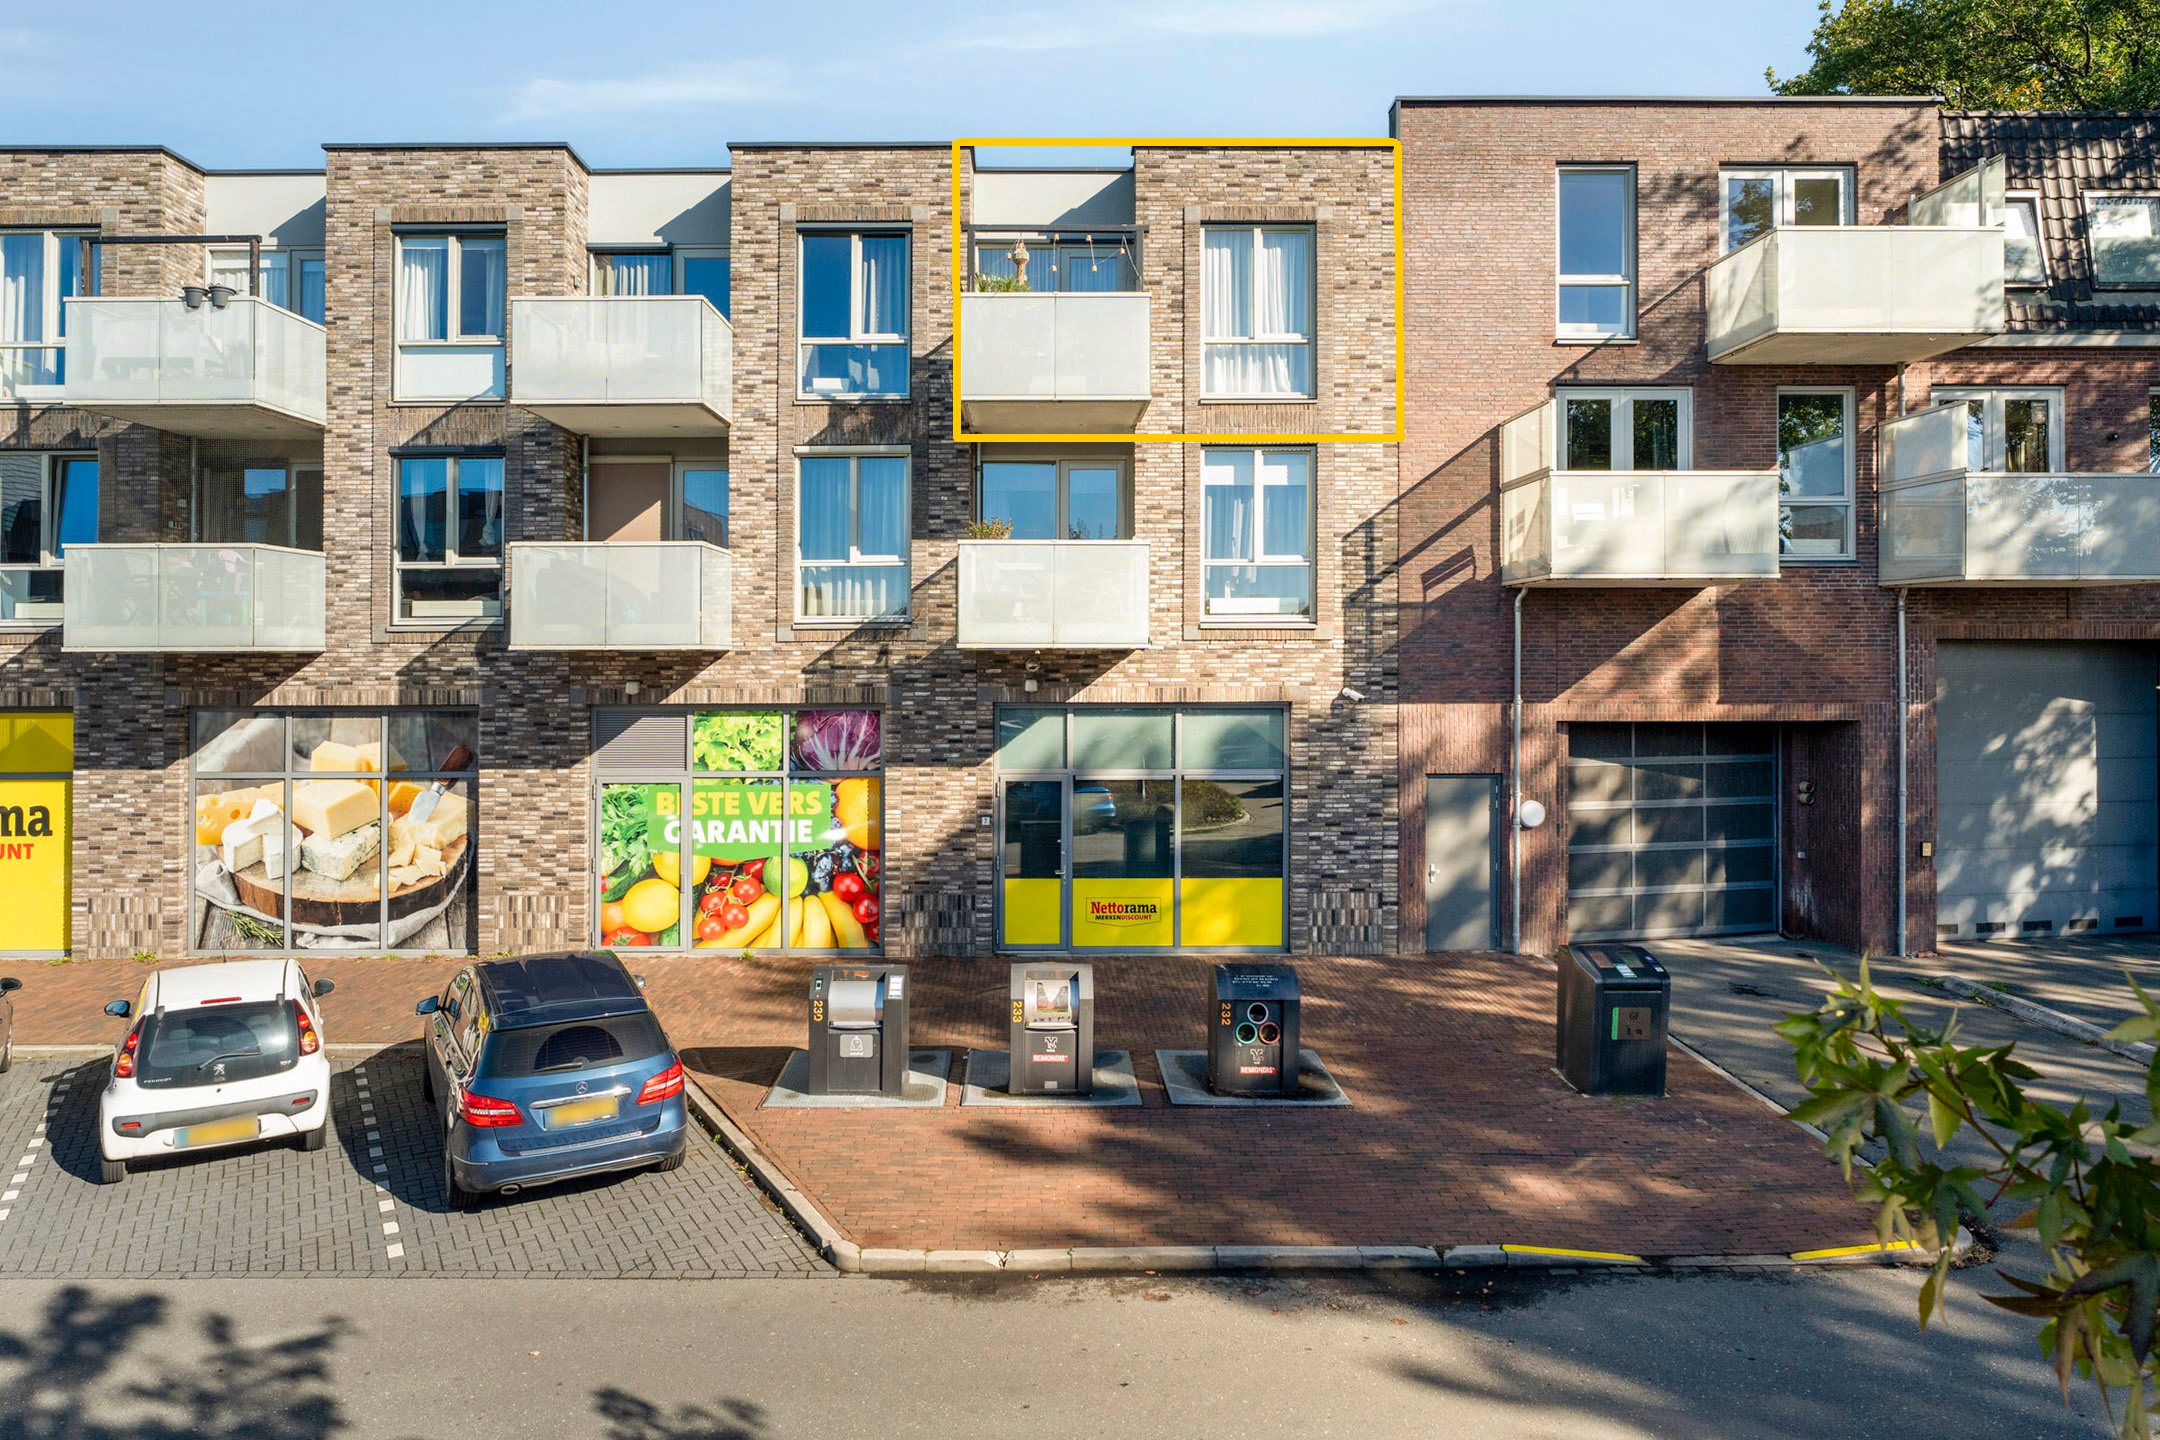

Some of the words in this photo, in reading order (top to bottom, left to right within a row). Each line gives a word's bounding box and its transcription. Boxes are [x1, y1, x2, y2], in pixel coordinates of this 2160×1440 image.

[746, 791, 822, 815] VERS
[664, 819, 813, 844] GARANTIE
[1090, 901, 1157, 914] Nettorama
[1012, 1000, 1023, 1023] 233
[1221, 1002, 1231, 1026] 232
